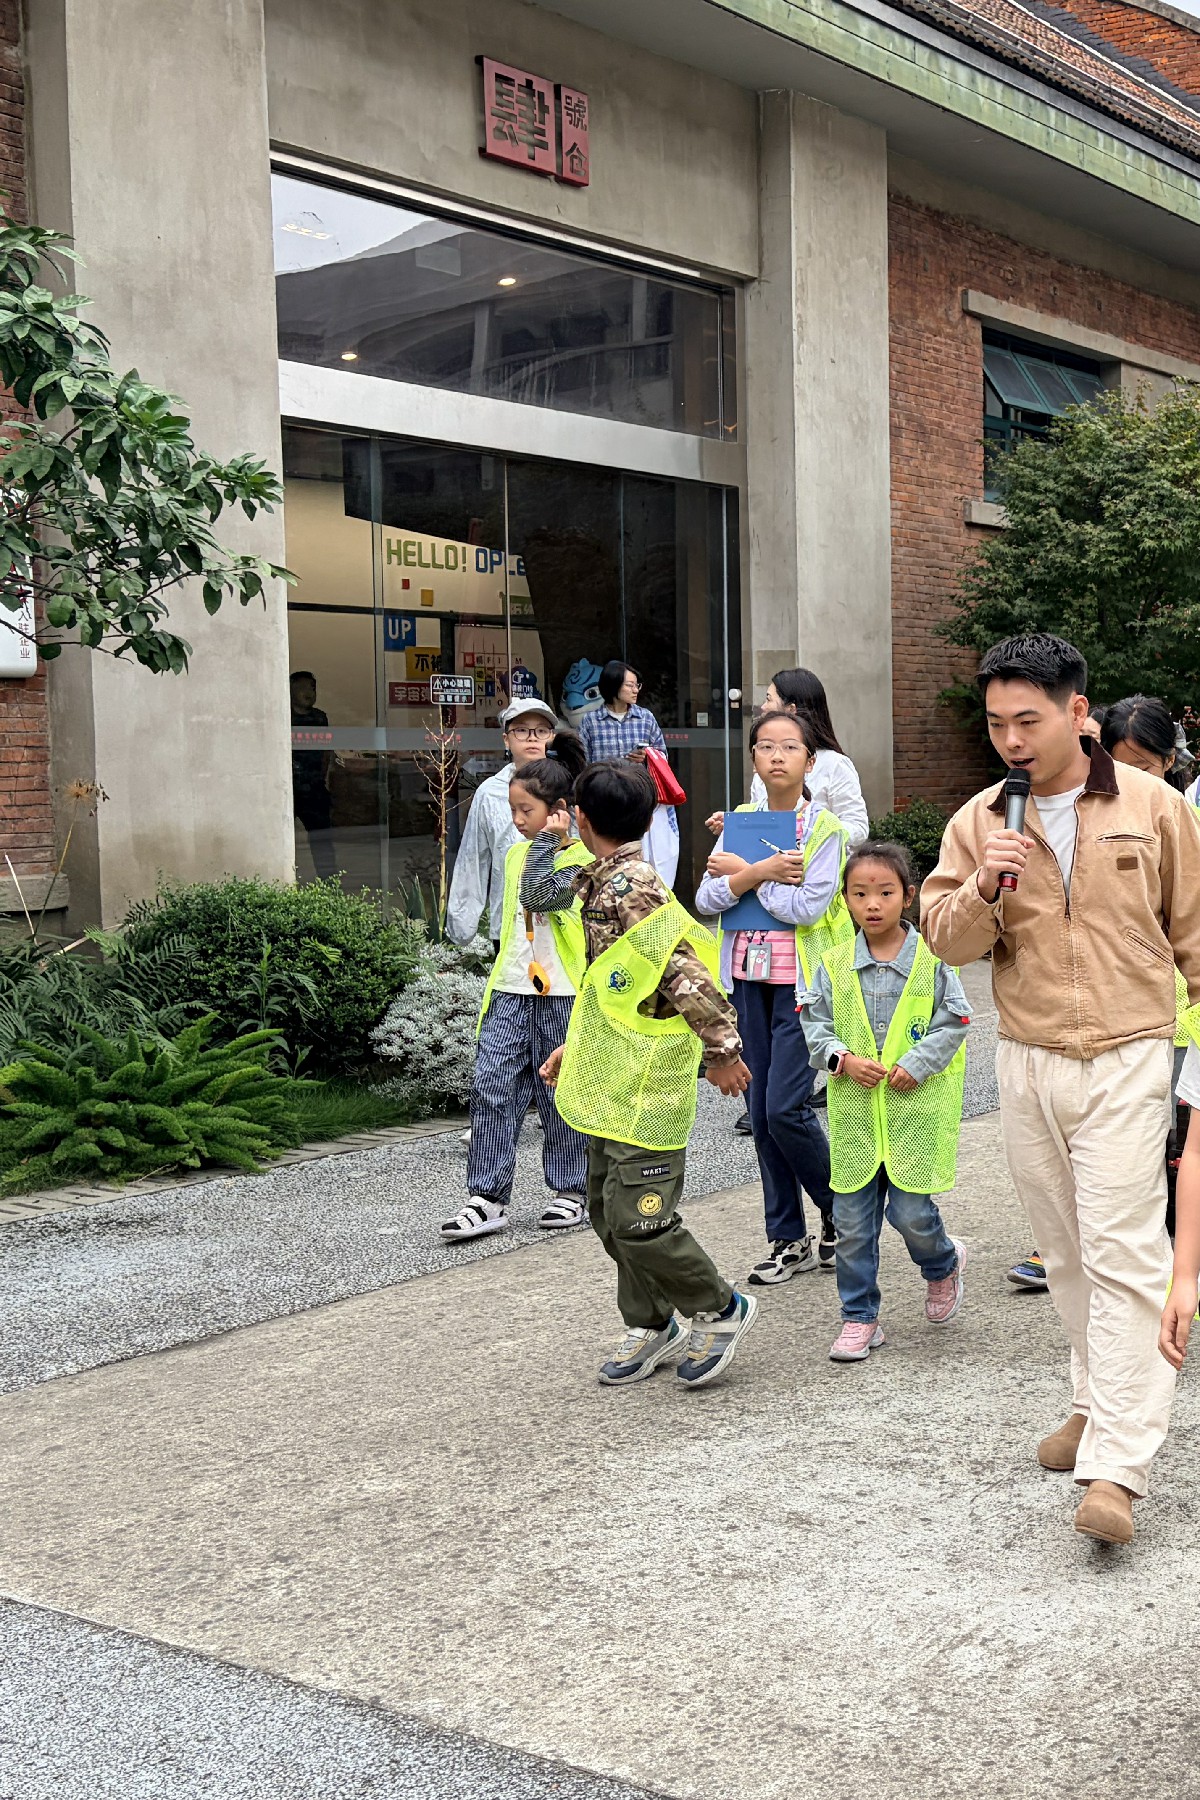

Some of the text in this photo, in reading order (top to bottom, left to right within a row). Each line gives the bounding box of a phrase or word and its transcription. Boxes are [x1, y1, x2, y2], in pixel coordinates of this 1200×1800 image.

[490, 72, 550, 161] 肆
[386, 538, 467, 573] HELLO!
[388, 618, 412, 640] UP
